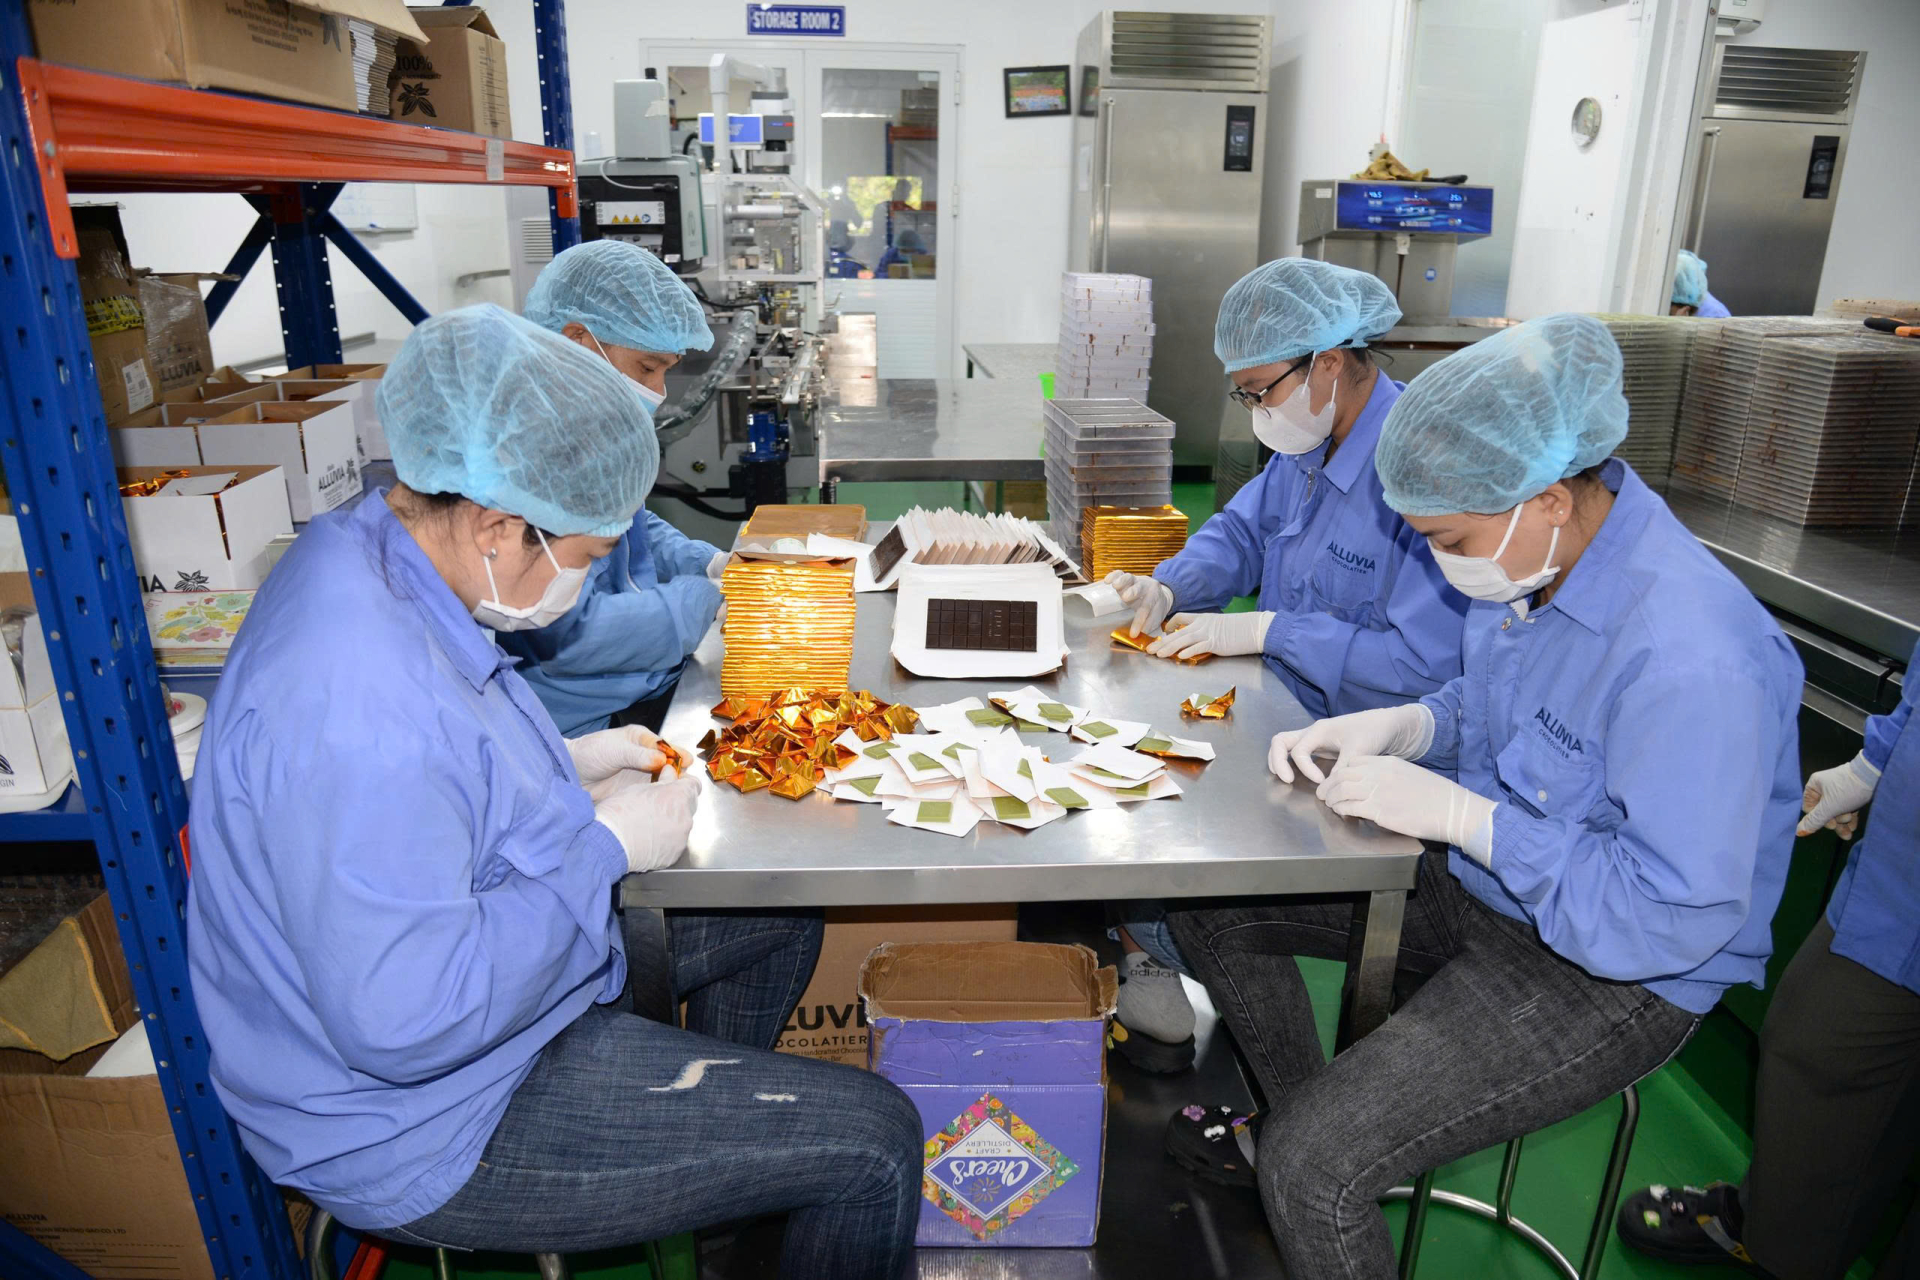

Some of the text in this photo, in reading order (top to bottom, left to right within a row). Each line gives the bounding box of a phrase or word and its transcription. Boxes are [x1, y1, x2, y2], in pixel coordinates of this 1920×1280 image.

[753, 11, 840, 30] STORAGE ROOM 2
[318, 466, 345, 492] ALLUVIA
[1326, 541, 1376, 572] ALLUVIA
[1331, 556, 1367, 575] CHOCOLATIER
[1534, 707, 1585, 755] ALLUVIA
[950, 1160, 1030, 1187] Cheers
